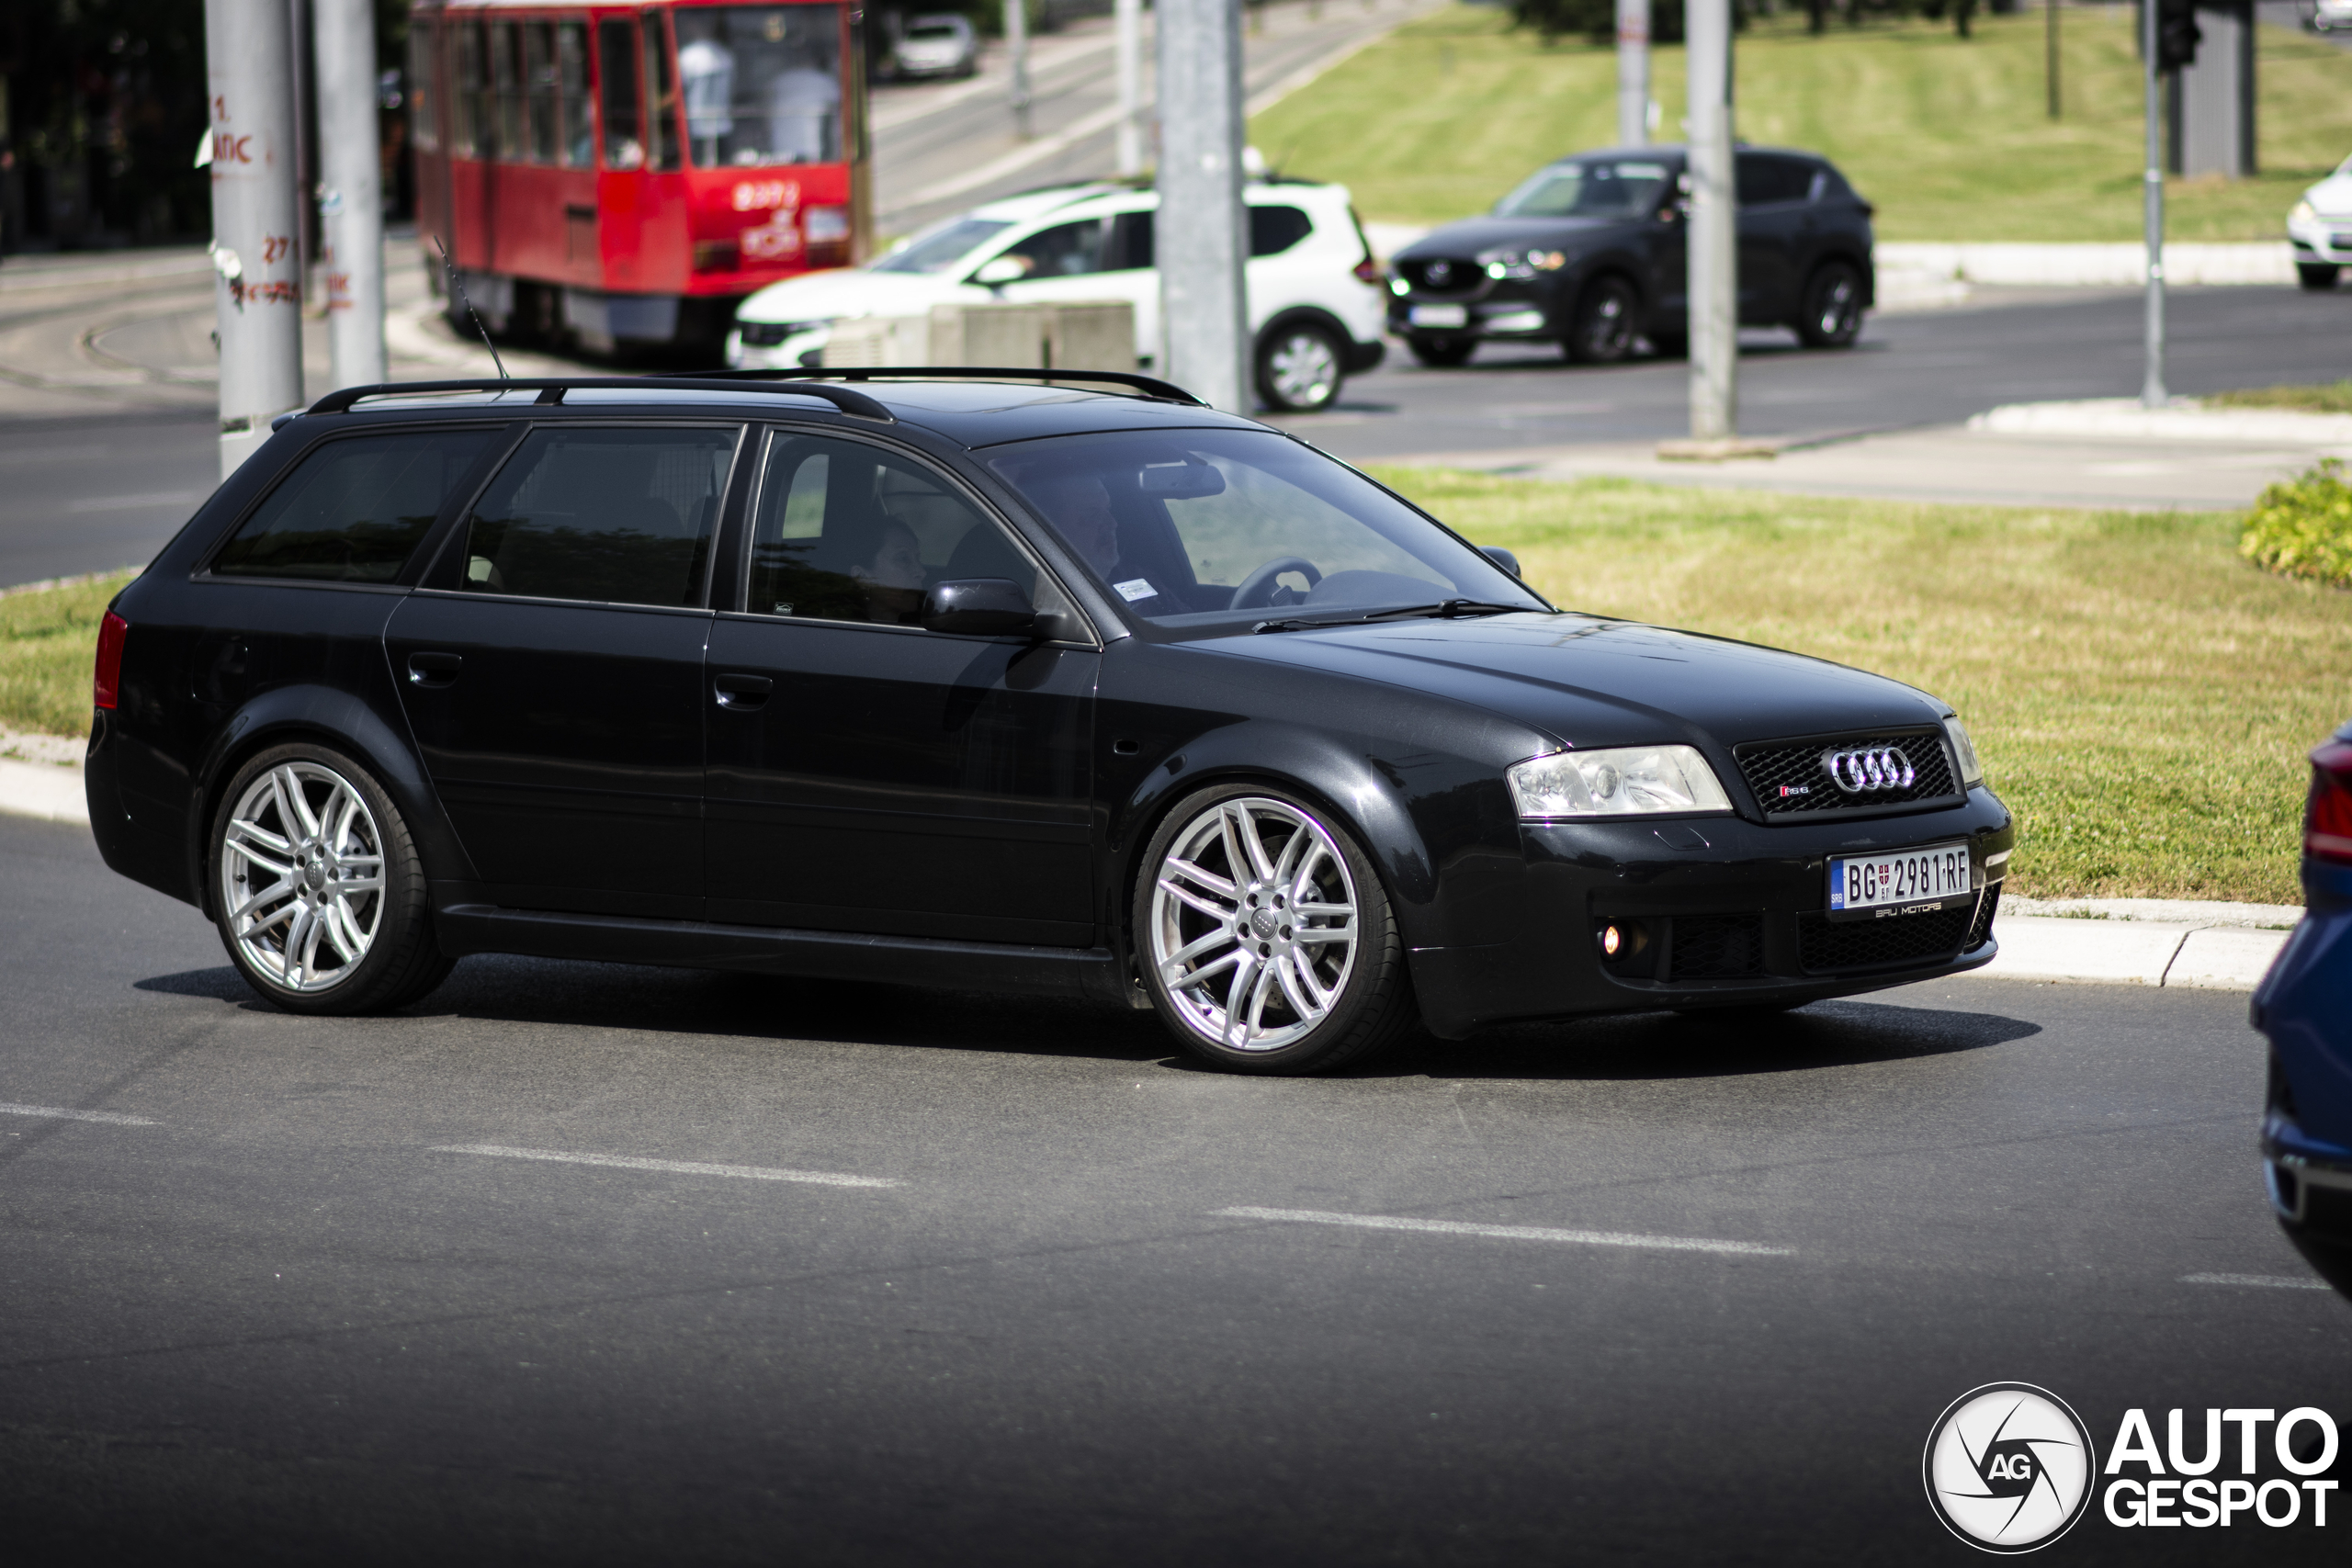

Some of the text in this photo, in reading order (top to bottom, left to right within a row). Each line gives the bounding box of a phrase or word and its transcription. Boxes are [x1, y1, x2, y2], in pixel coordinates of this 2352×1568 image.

[1849, 863, 1875, 902] BG
[1831, 894, 1843, 904] SRB
[1901, 902, 1942, 915] MOTORS
